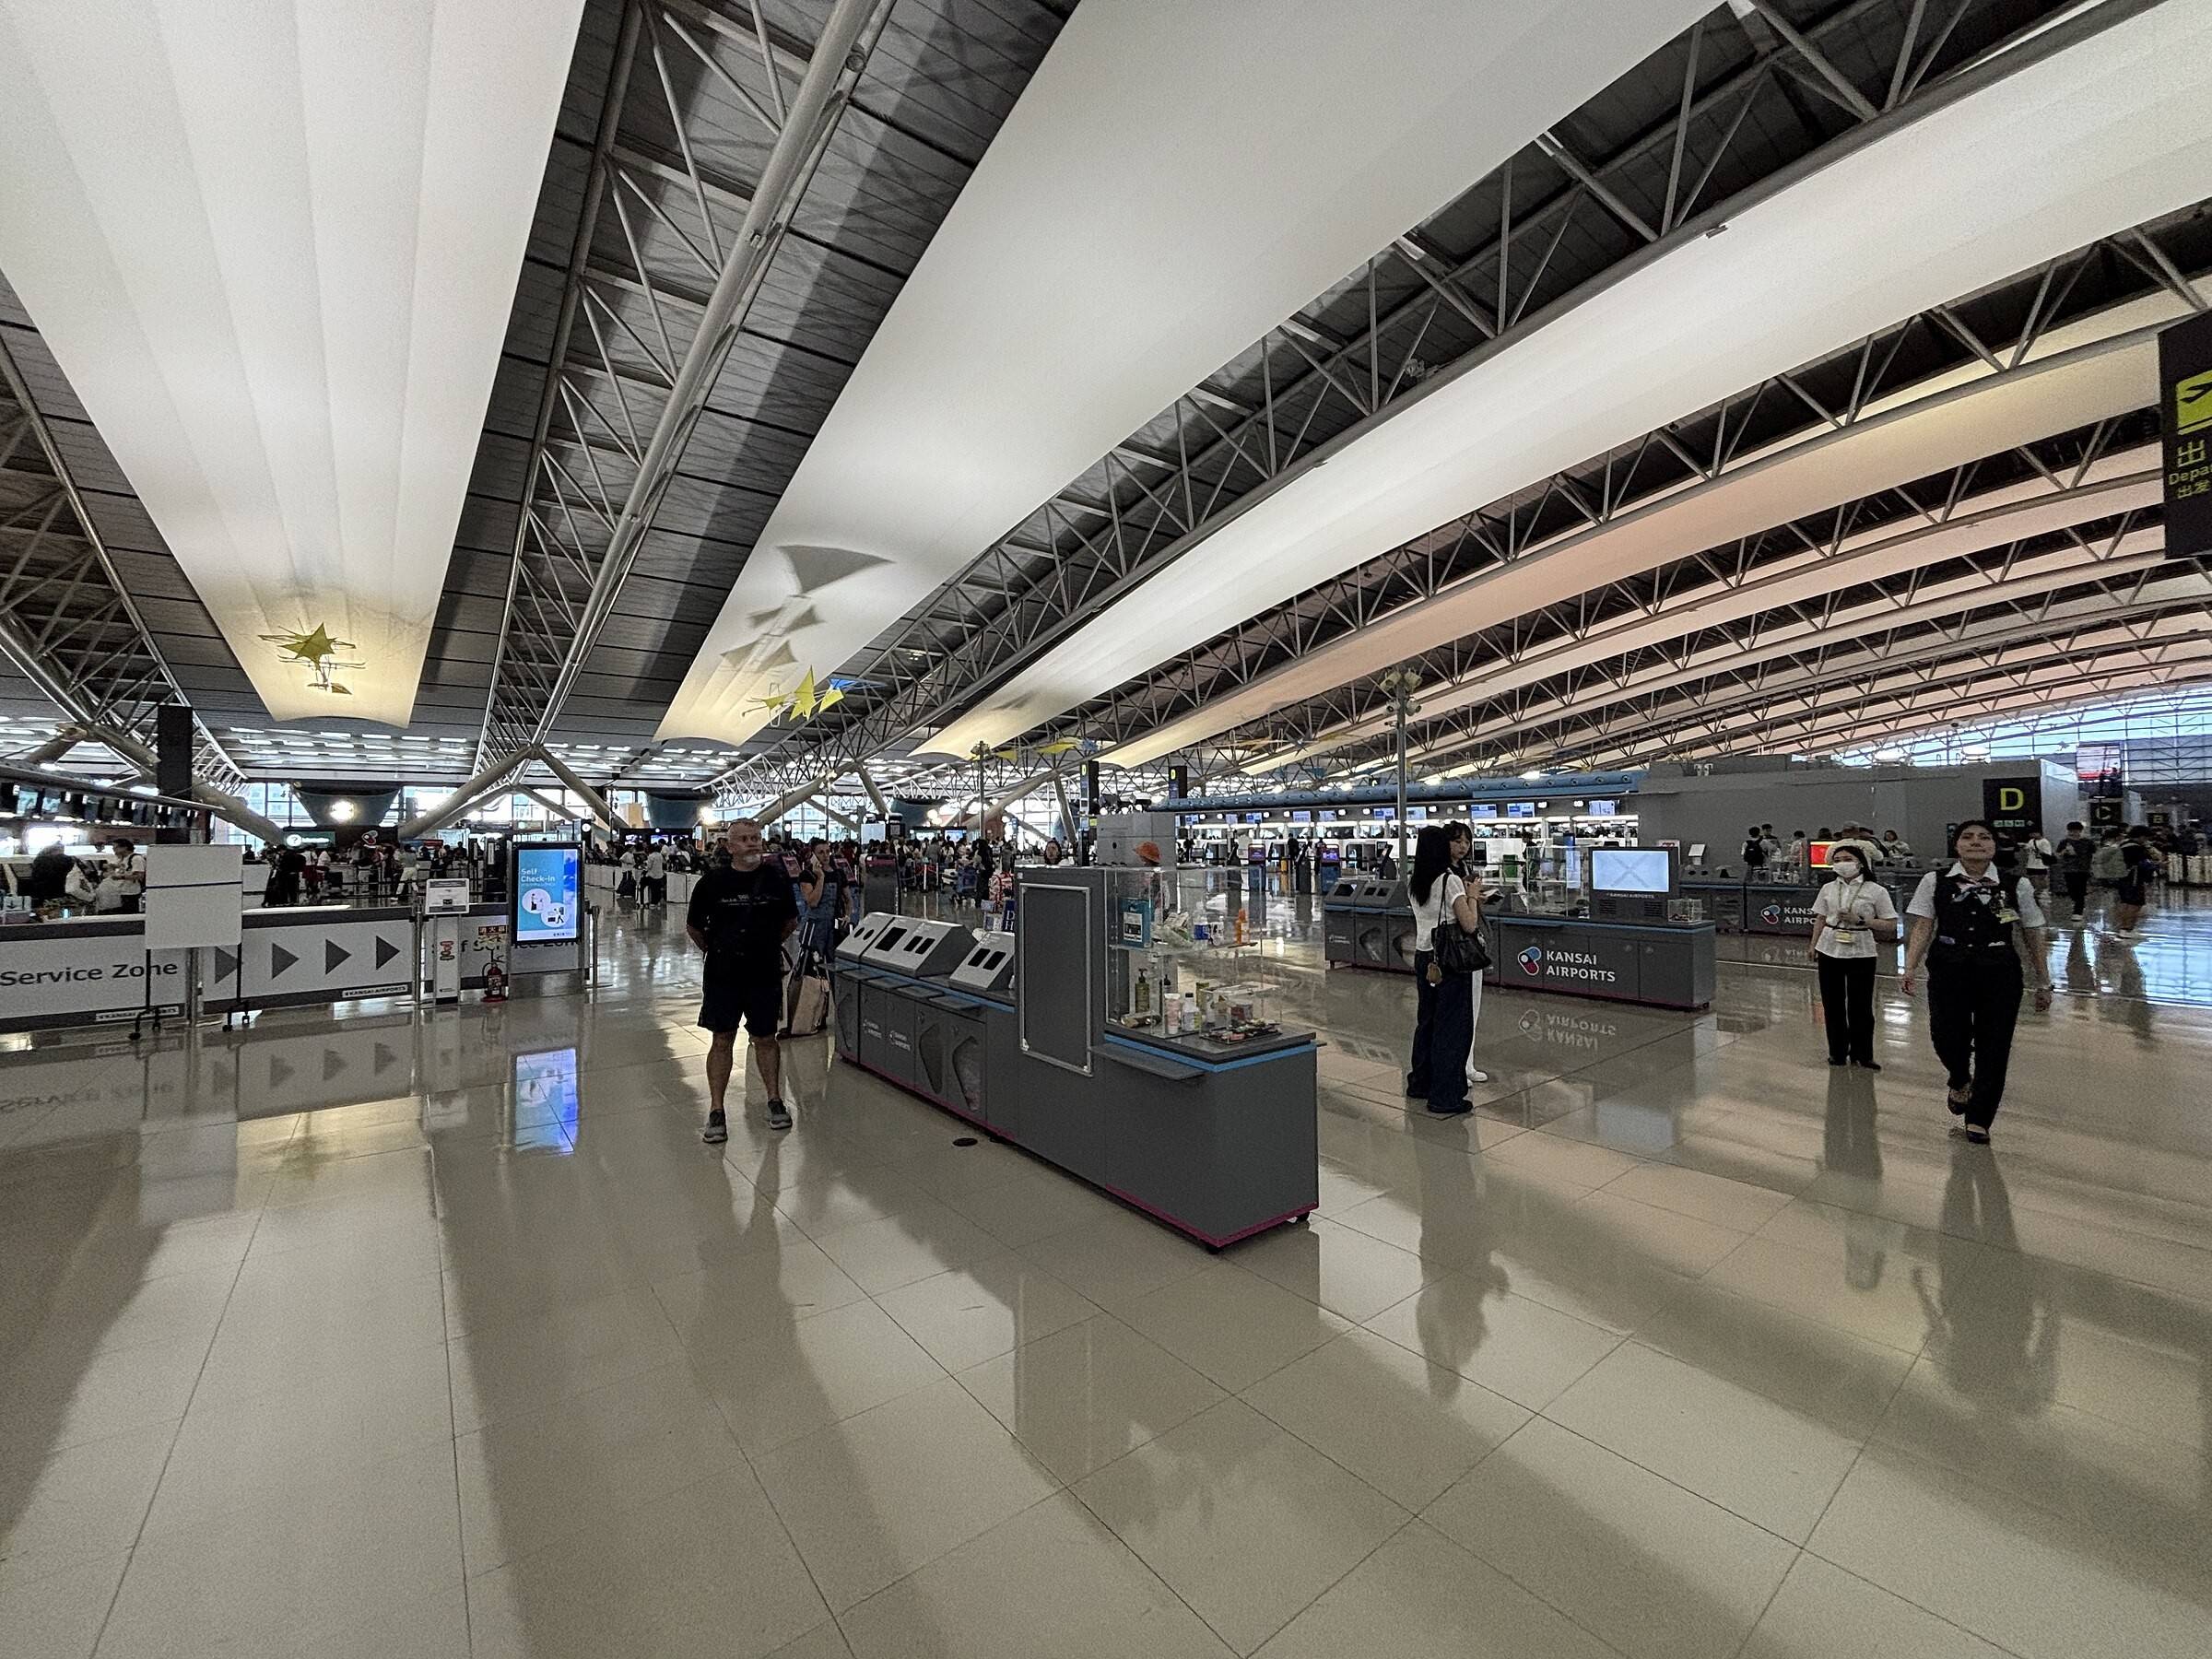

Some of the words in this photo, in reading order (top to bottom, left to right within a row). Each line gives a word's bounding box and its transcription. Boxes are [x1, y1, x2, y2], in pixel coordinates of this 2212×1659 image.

[1999, 787, 2024, 811] D
[2095, 806, 2112, 820] C
[1783, 907, 1817, 915] KANS
[1783, 916, 1816, 925] AIRPO
[1547, 950, 1597, 965] KANSAI
[0, 968, 103, 986] Service
[112, 963, 178, 979] Zone
[1546, 965, 1616, 982] AIRPORTS
